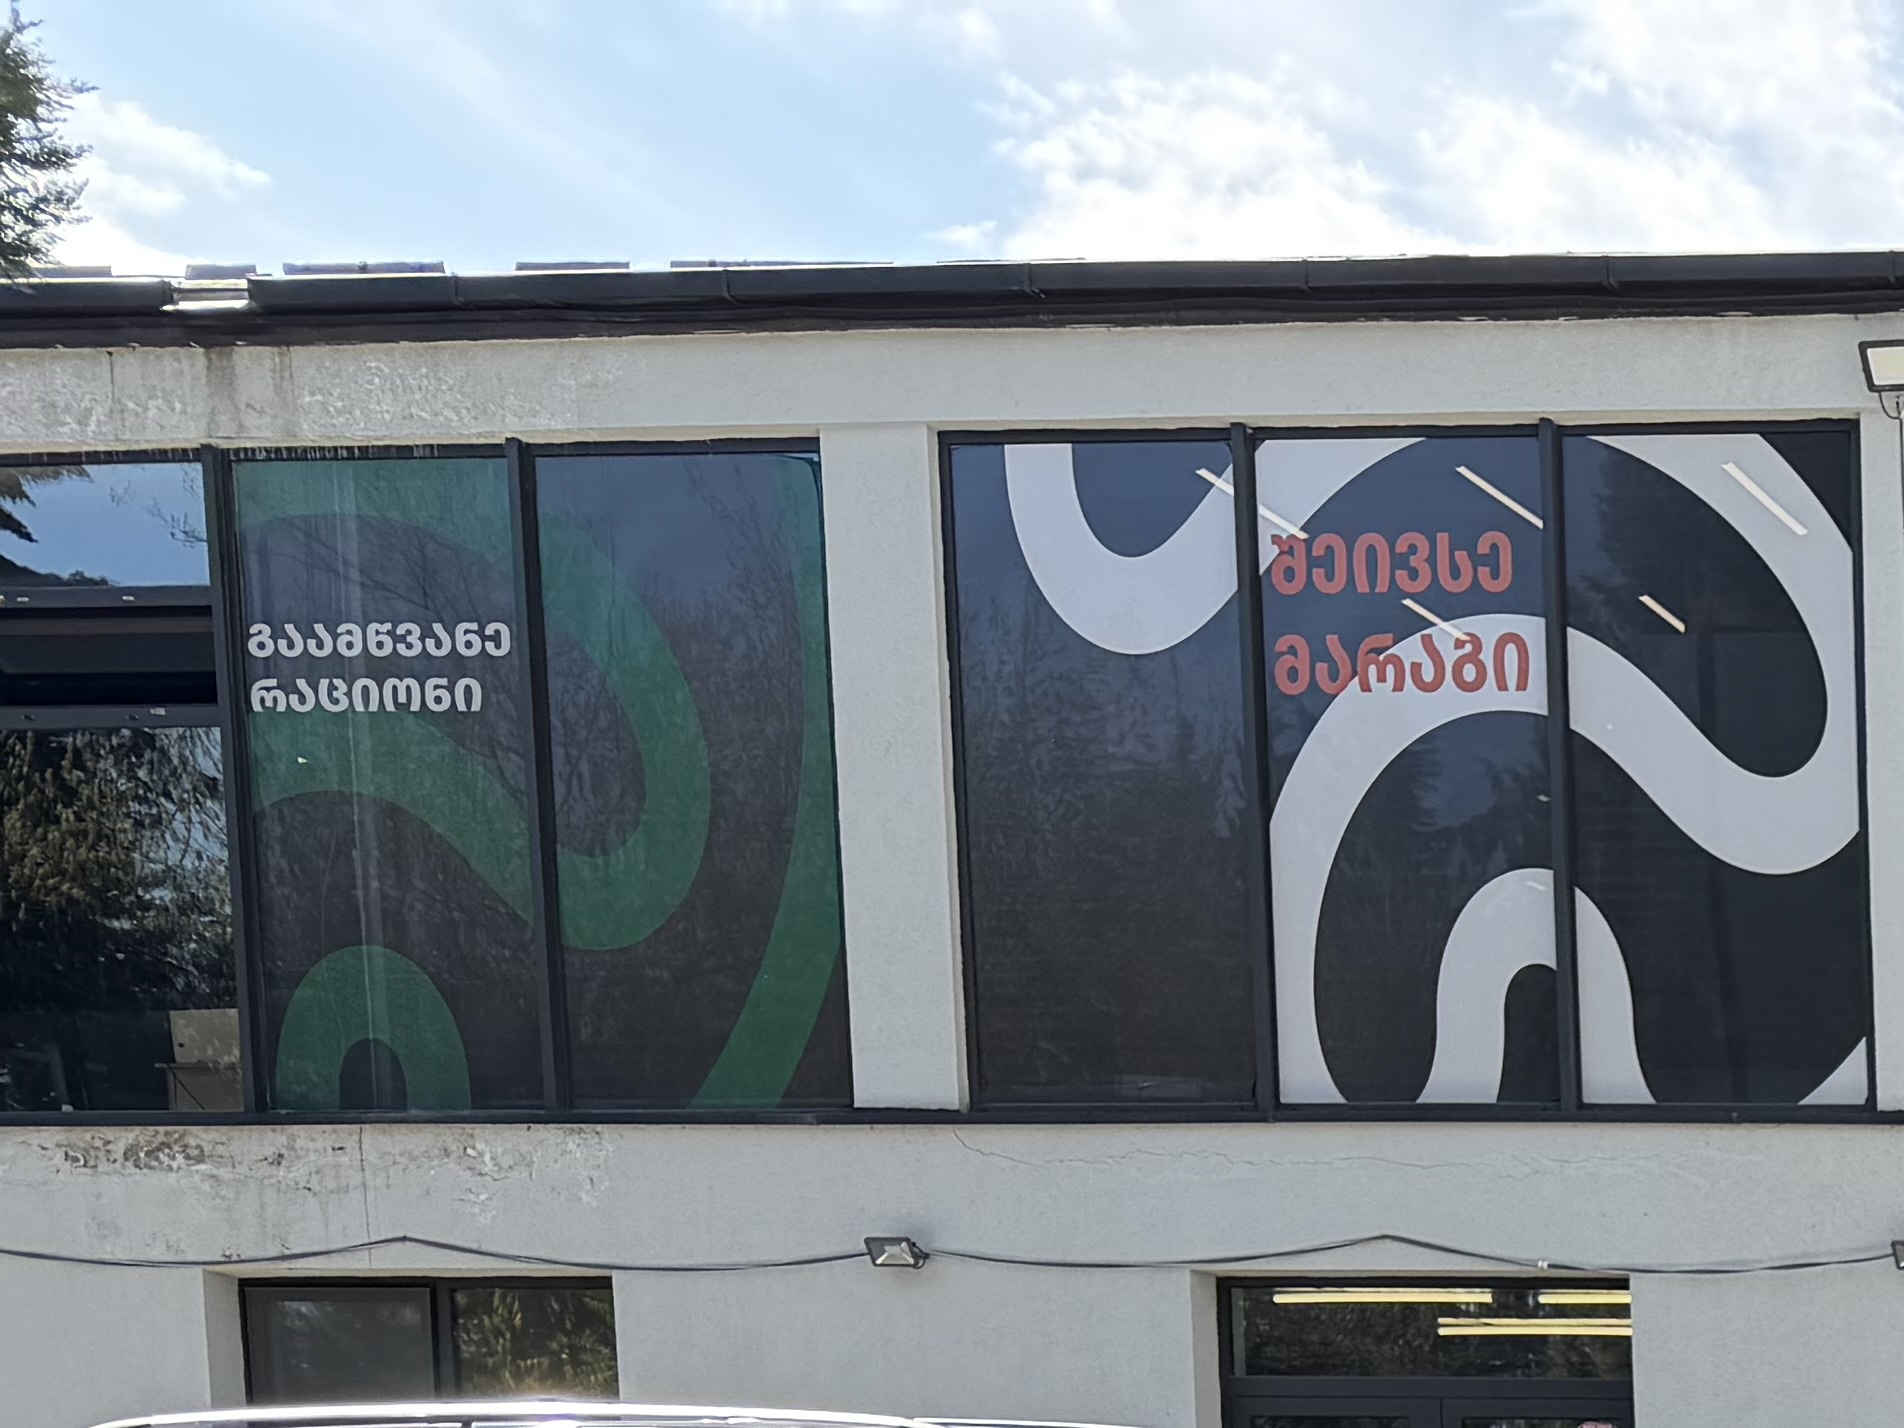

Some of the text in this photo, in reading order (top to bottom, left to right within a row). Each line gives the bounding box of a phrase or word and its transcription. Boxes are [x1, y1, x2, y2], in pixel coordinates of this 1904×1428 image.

[1270, 530, 1513, 595] შეივსე
[247, 621, 512, 658] გაამწვანე
[1274, 631, 1530, 695] მარაგი
[250, 677, 482, 713] რაციონი
